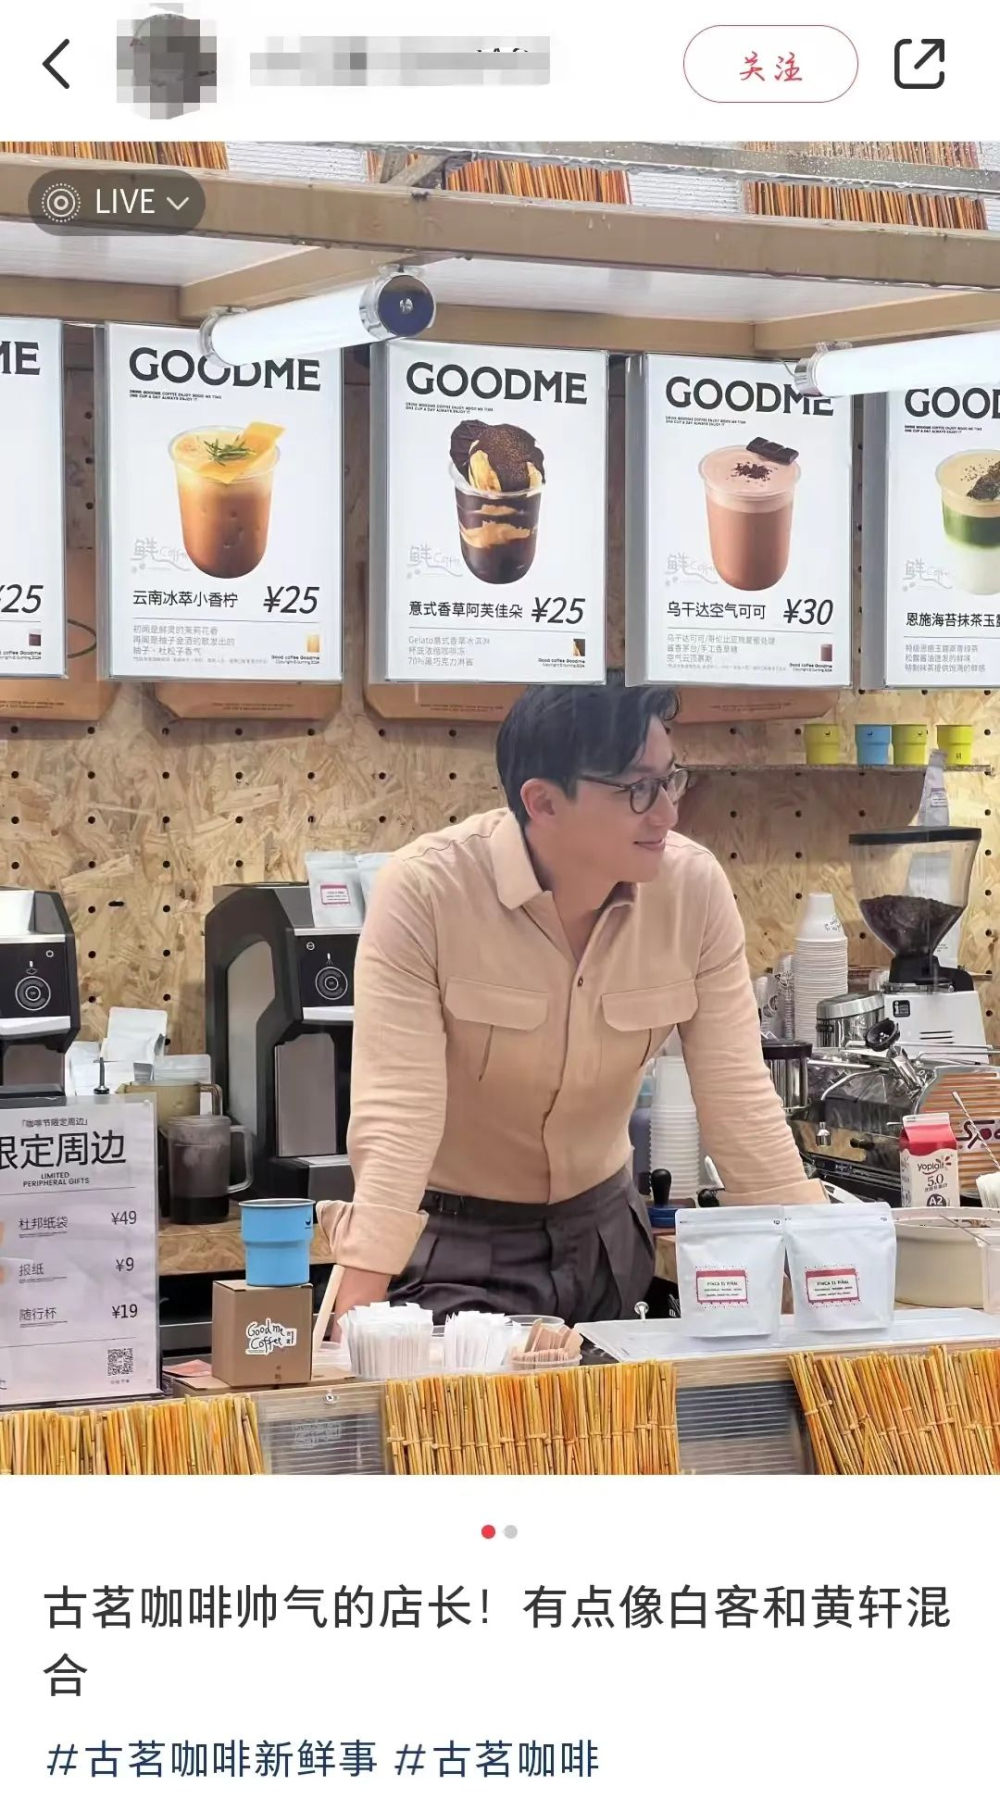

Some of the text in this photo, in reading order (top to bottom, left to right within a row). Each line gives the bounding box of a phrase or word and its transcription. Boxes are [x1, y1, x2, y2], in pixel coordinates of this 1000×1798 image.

[130, 347, 320, 391] GOODME
[406, 362, 587, 405] GOODME
[0, 583, 44, 614] 25
[133, 590, 238, 608] 云南冰萃小香柠
[264, 586, 320, 614] ¥25
[409, 601, 522, 618] 意式香草阿芙佳朵
[531, 597, 586, 624] ¥25
[667, 601, 766, 619] 乌干达空气可可
[784, 599, 833, 625] ¥30
[23, 1178, 67, 1187] PERIPHERAL
[927, 1174, 944, 1186] 5.0
[929, 1196, 943, 1206] A2
[19, 1216, 68, 1230] 杜邦纸袋
[111, 1211, 137, 1225] ¥49
[19, 1263, 44, 1276] 报纸
[116, 1257, 134, 1272] ¥9
[20, 1307, 57, 1321] 随行杯
[112, 1304, 137, 1318] ¥19
[248, 1320, 272, 1337] Good
[251, 1336, 283, 1353] Coffee
